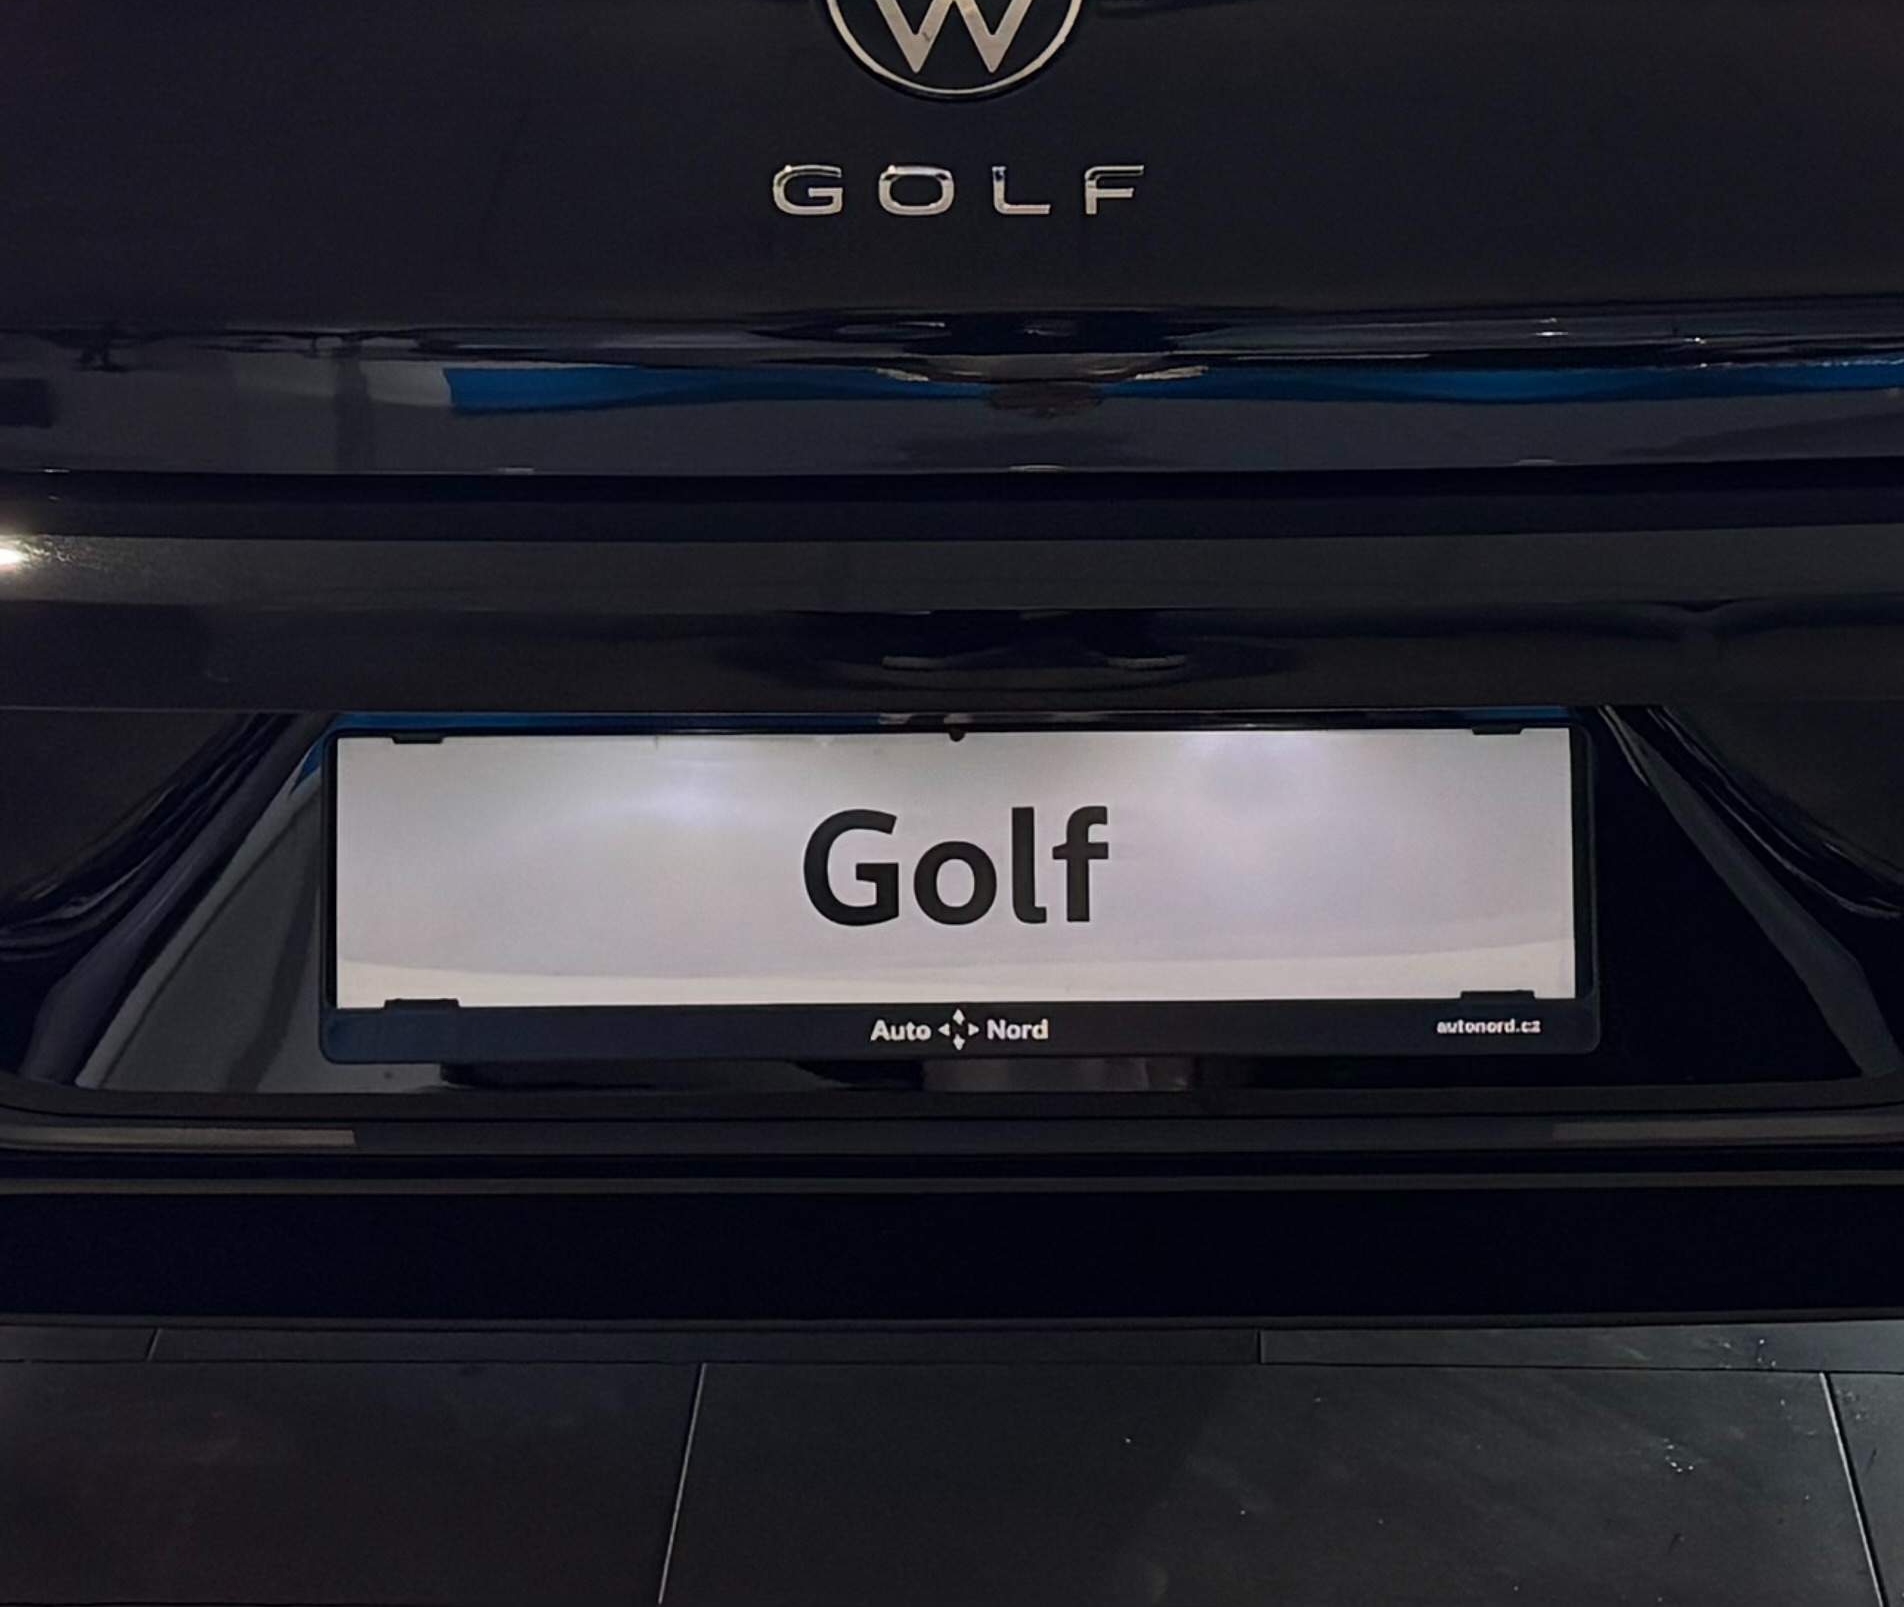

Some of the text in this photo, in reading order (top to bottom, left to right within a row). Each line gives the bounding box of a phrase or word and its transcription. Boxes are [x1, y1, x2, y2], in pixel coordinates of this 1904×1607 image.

[772, 164, 1145, 216] GOLF
[803, 805, 1109, 927] Golf
[870, 1018, 1049, 1042] Auto Nord
[1436, 1017, 1542, 1035] autonord.cz
